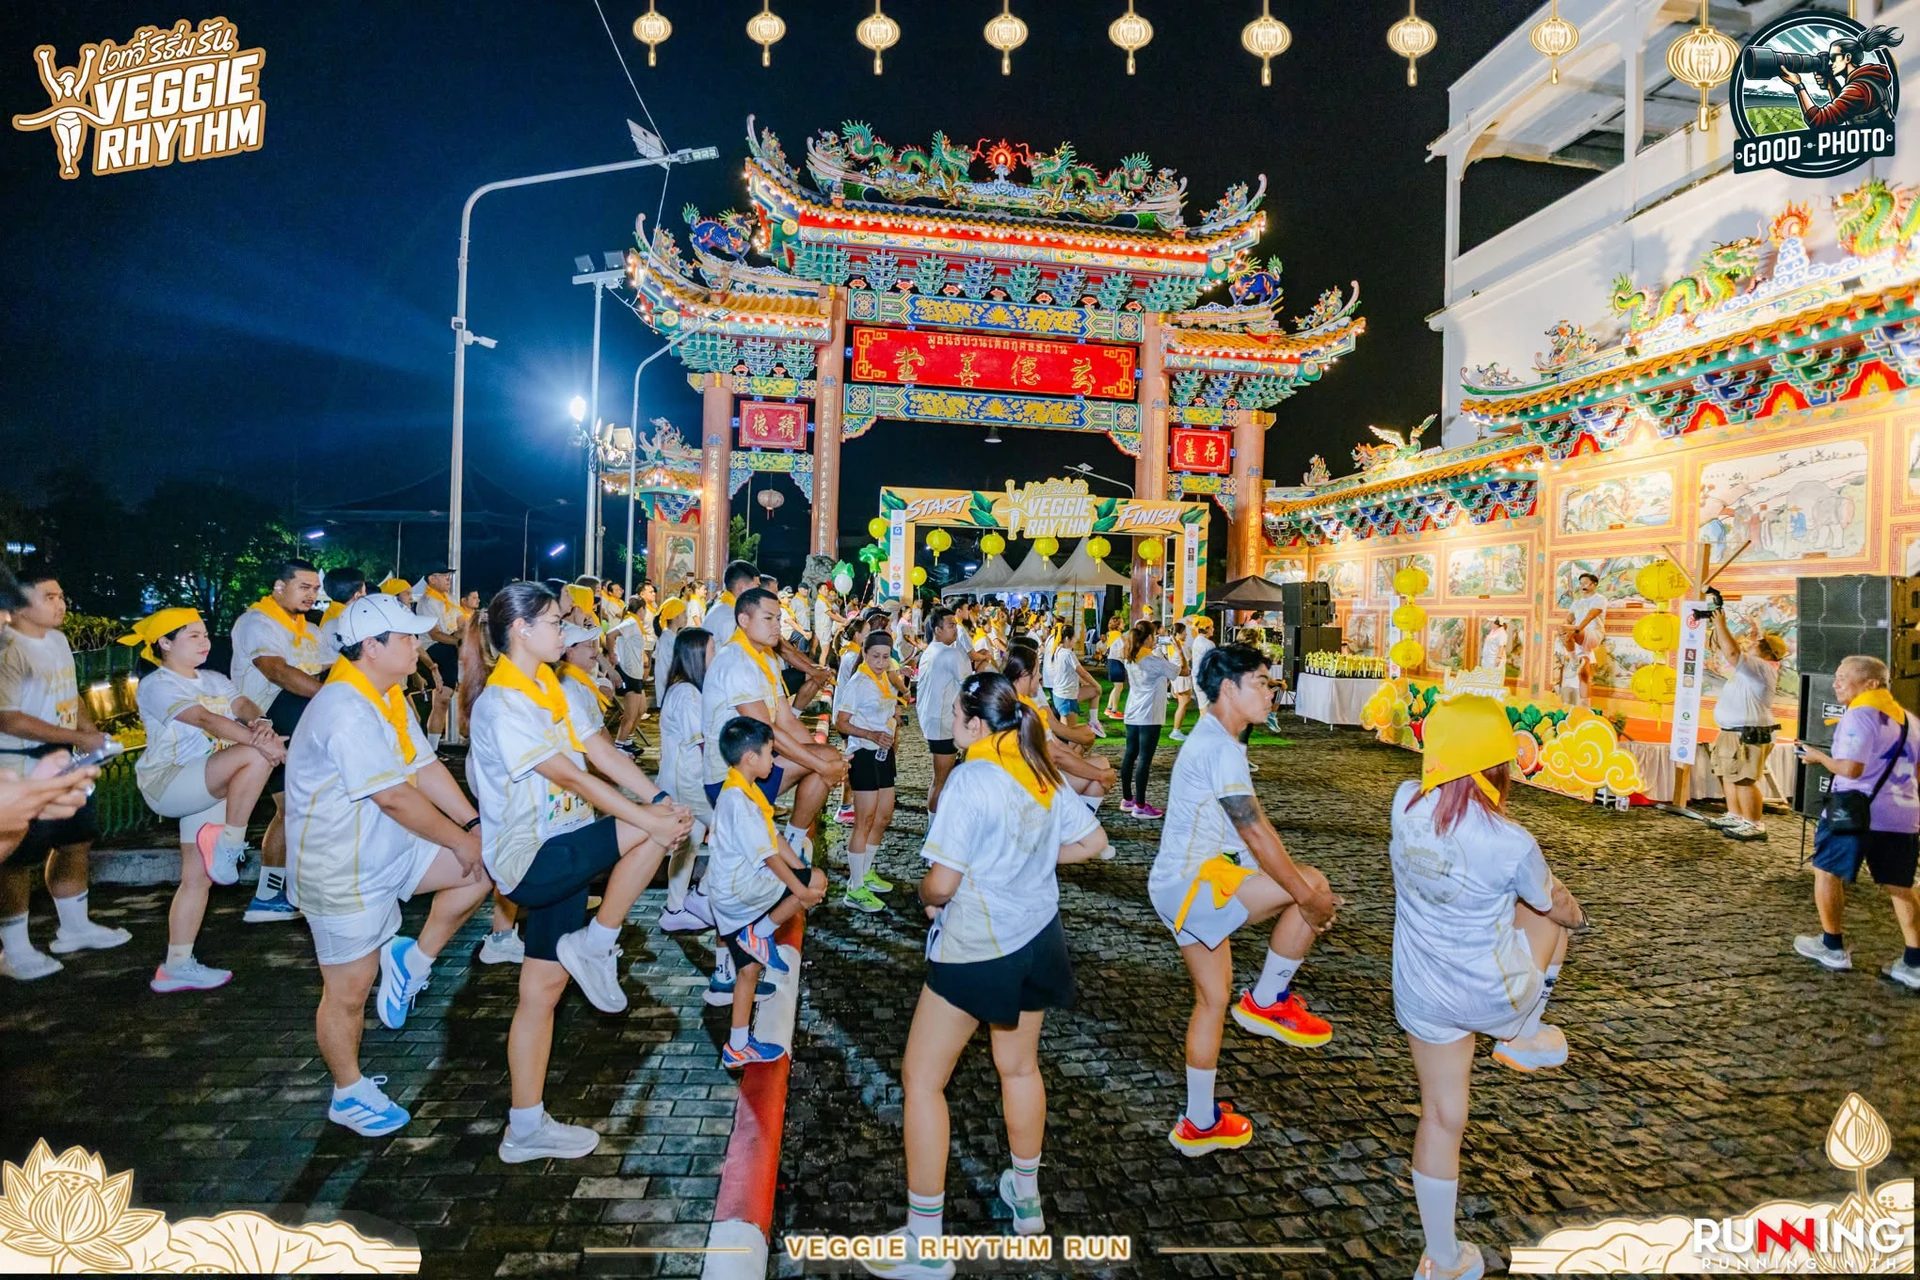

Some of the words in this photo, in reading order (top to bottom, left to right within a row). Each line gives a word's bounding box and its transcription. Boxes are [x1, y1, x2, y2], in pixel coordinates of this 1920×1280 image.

[905, 494, 971, 521] START
[1028, 497, 1093, 517] VEGGIE
[1119, 504, 1182, 528] FINISH
[1026, 518, 1092, 536] RHYTHM
